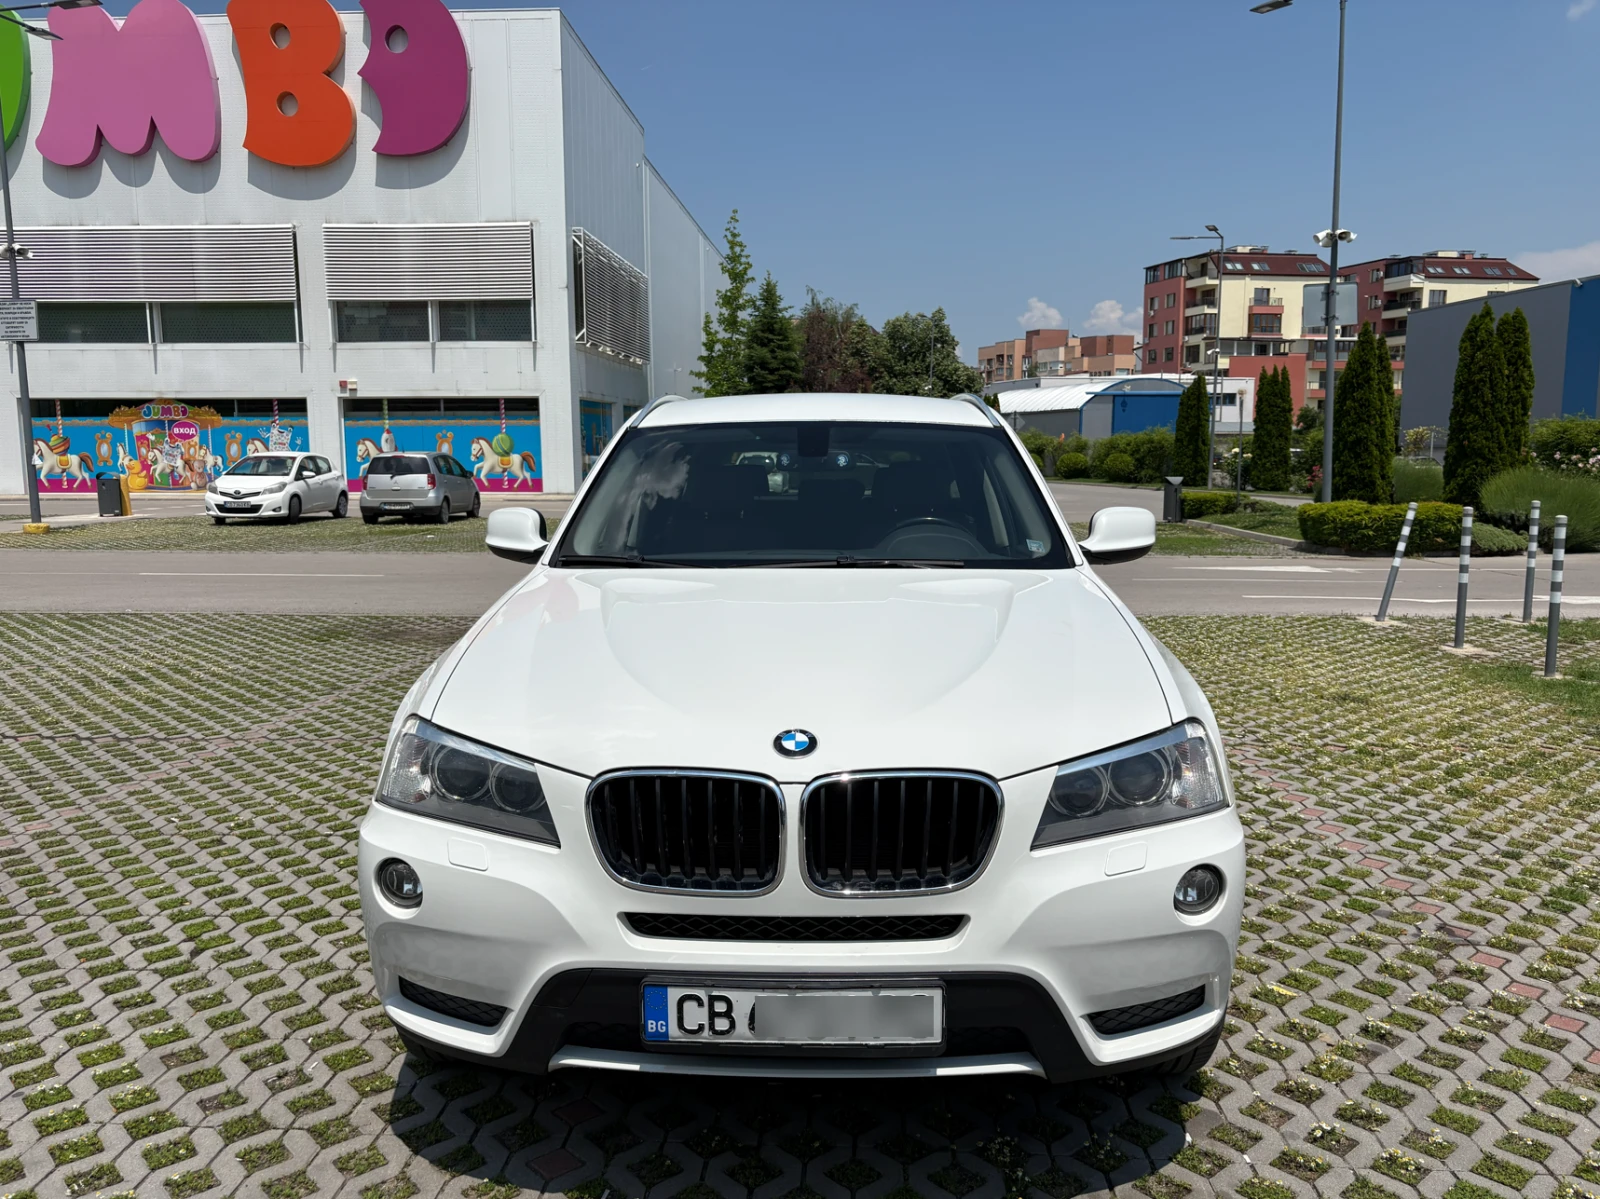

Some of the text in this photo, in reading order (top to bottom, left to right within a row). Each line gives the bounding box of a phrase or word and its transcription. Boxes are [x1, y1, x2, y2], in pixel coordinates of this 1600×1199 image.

[0, 0, 471, 168] MBO
[142, 404, 189, 418] JUMBO
[647, 1020, 666, 1032] BG
